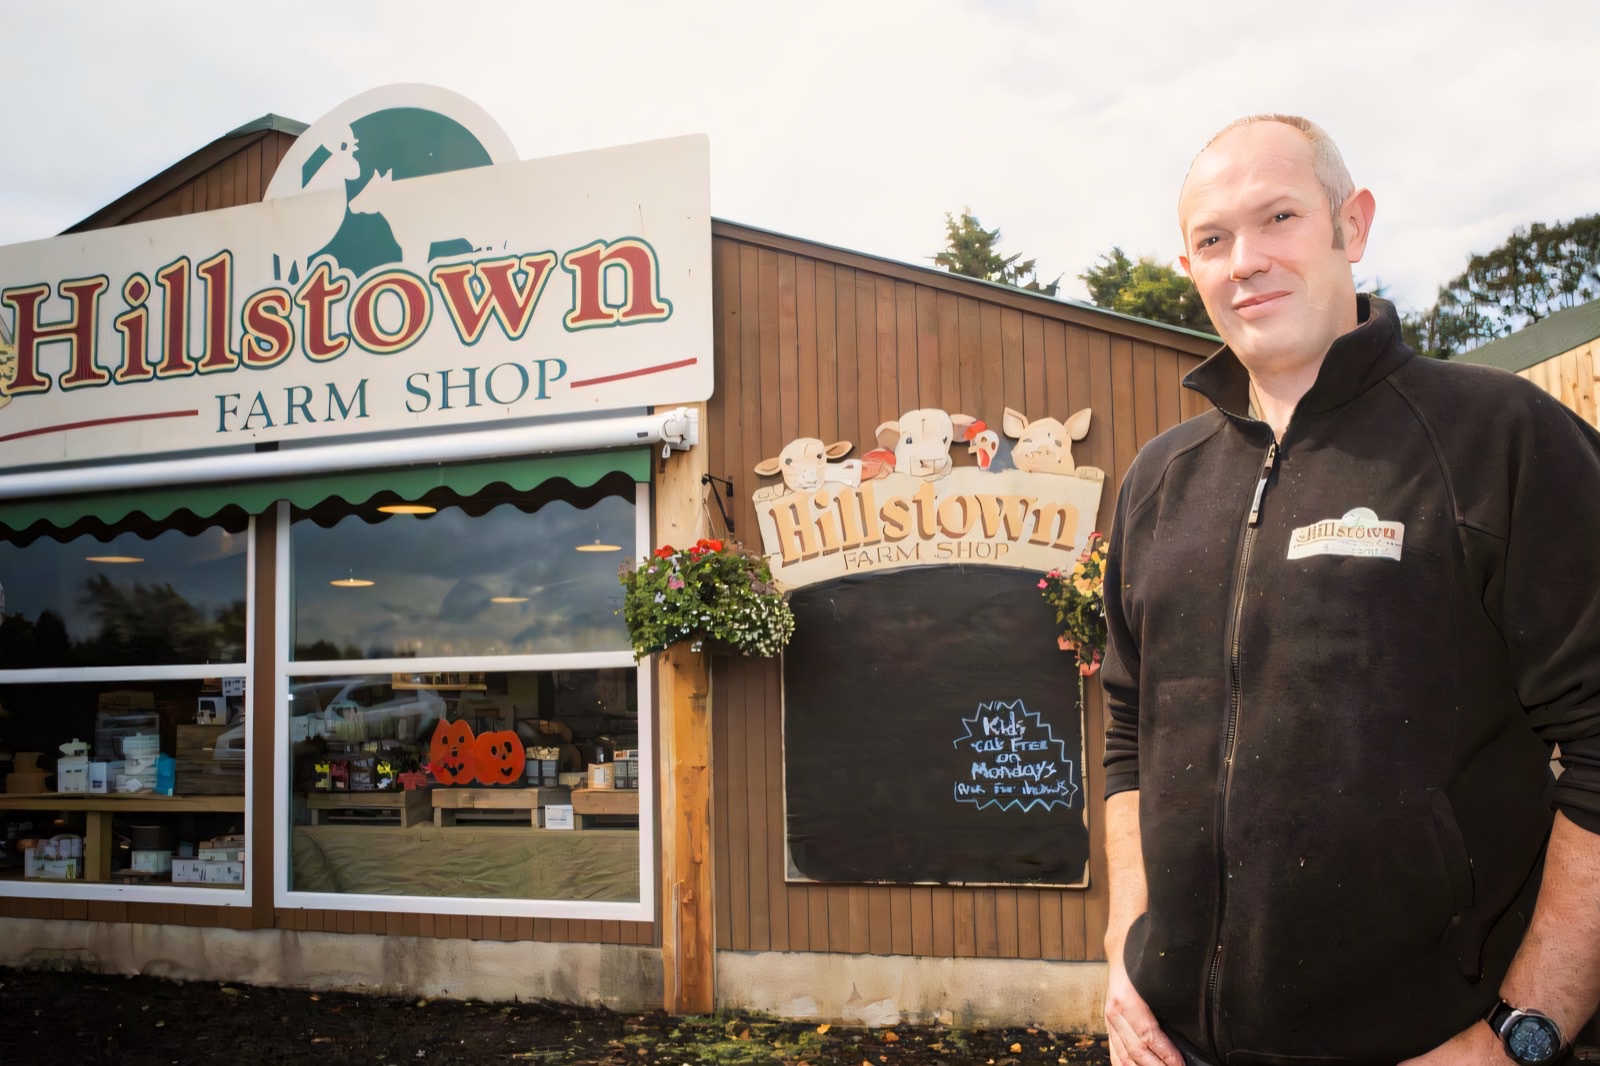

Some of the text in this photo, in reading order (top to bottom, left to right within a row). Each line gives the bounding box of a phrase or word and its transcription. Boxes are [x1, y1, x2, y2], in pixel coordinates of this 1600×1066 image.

[2, 236, 673, 398] Hillstown
[215, 358, 568, 433] FARM SHOP
[768, 481, 1080, 568] Hillstown
[842, 541, 1010, 570] FARM SHOP
